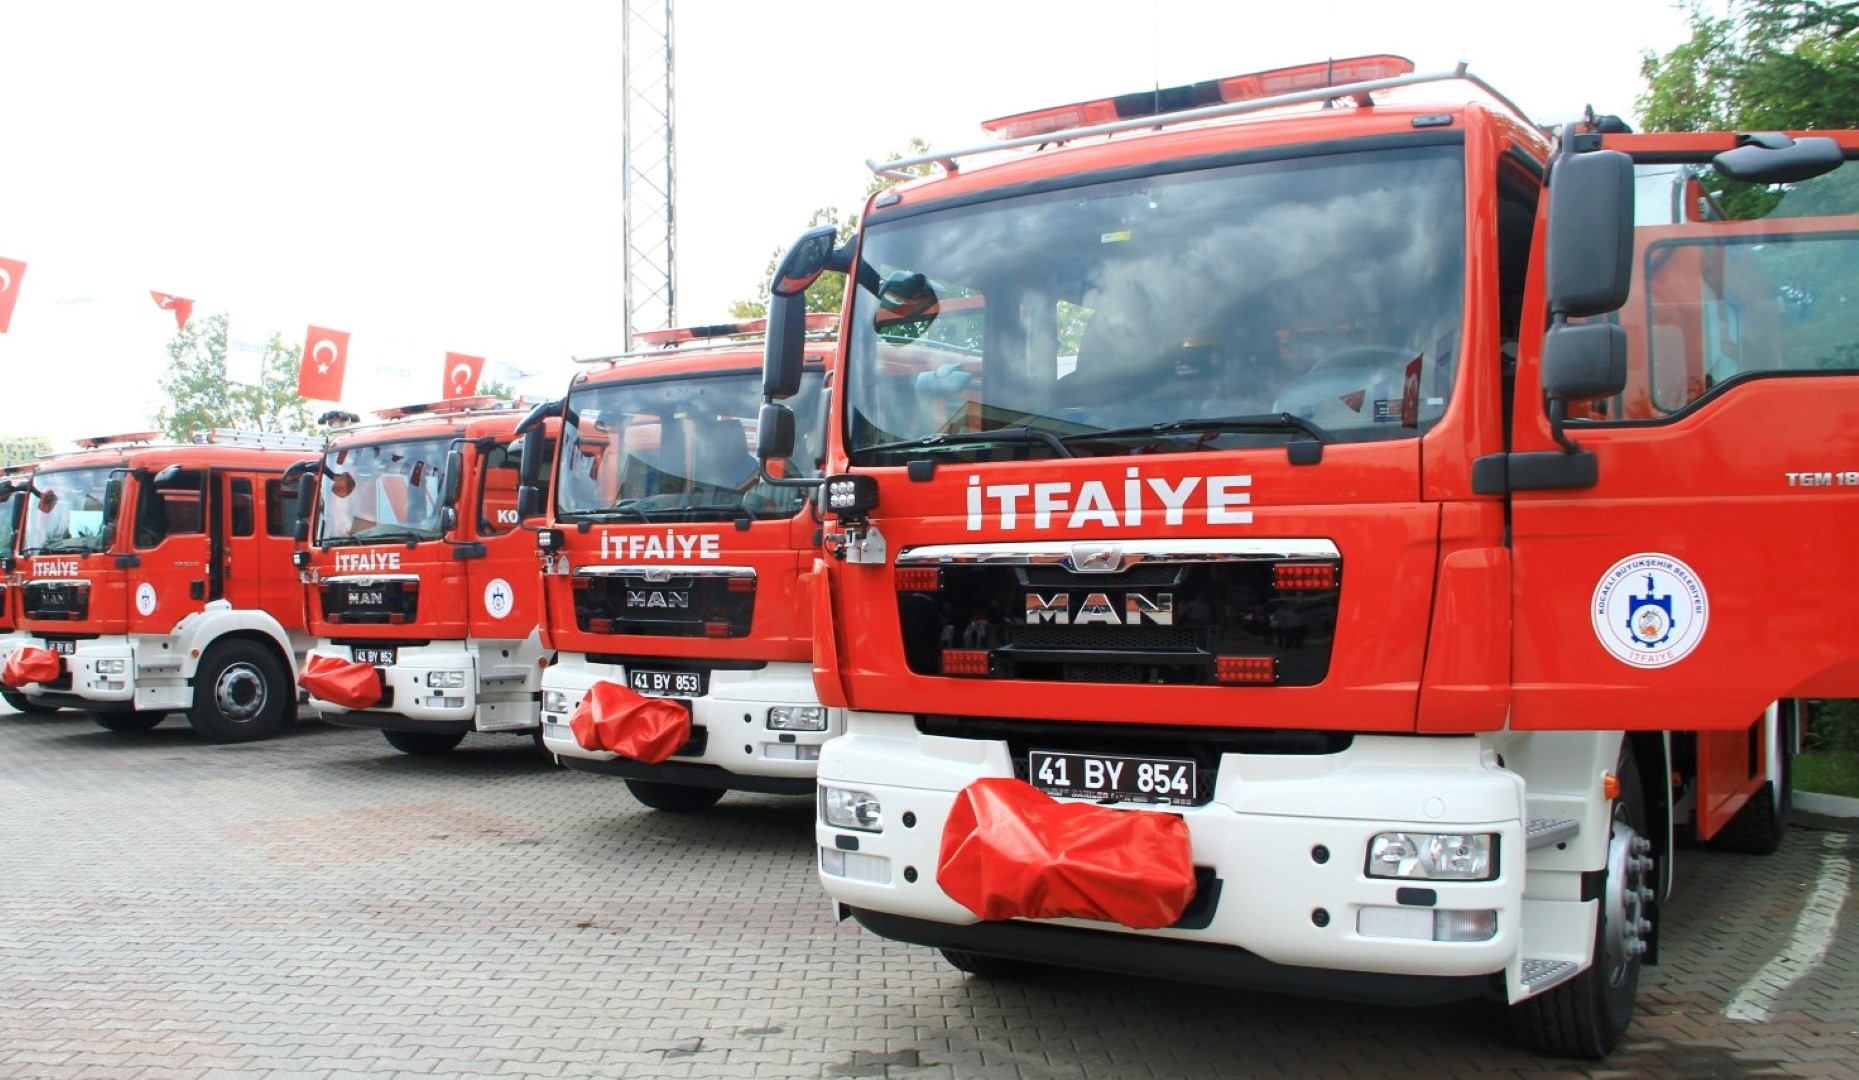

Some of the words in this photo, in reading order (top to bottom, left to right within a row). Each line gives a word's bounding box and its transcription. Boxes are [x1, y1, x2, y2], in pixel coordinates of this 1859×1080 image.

[1785, 472, 1832, 487] TGM
[966, 467, 1253, 531] İTFAİYE
[601, 529, 721, 559] İTFAİYE
[33, 558, 78, 576] İTFAİYE
[335, 549, 400, 572] İTFAİYE
[348, 592, 382, 605] MAN
[626, 591, 689, 608] MAN
[1025, 592, 1173, 625] MAN
[358, 651, 367, 662] 41
[368, 650, 378, 662] BY
[1629, 651, 1674, 663] İTFAİYE
[634, 673, 649, 688] 41
[654, 674, 670, 689] BY
[676, 675, 697, 691] 853
[1038, 757, 1071, 786] 41
[1085, 759, 1124, 789] BY
[1137, 763, 1189, 795] 854
